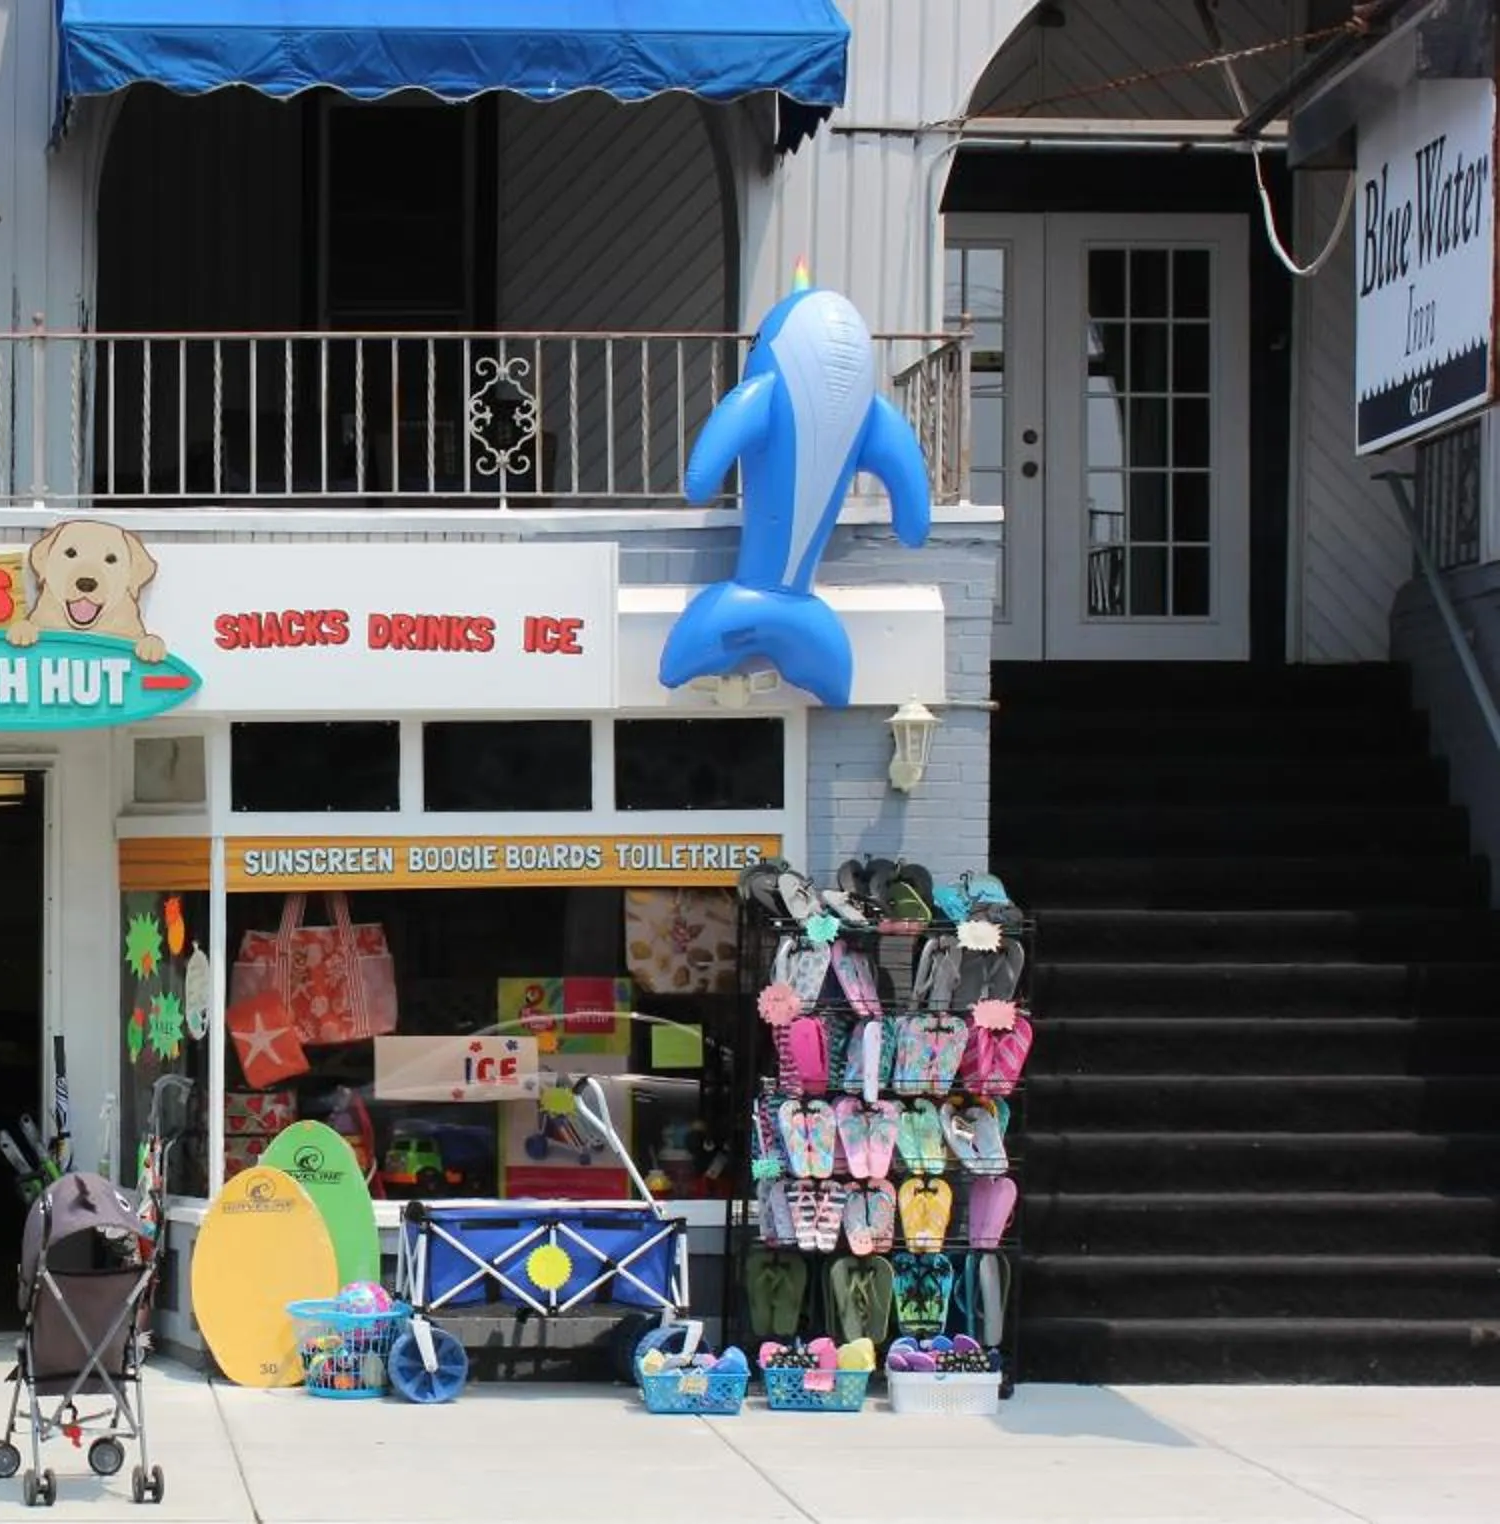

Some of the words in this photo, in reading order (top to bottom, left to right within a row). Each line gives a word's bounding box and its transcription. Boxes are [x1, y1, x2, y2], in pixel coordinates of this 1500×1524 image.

[1360, 162, 1412, 298] Blue
[1415, 134, 1488, 269] Water
[1405, 284, 1436, 357] Inn
[1410, 379, 1433, 417] 617
[214, 608, 351, 651] SNACKS
[367, 613, 497, 653] DRINKS
[523, 615, 584, 655] ICE
[41, 657, 131, 706] HUT
[244, 847, 394, 876] SUNSCREEN
[407, 846, 499, 873] BOOGIE
[505, 845, 603, 871] BOARDS
[614, 843, 762, 870] TOILETRIES
[465, 1057, 517, 1085] ICE
